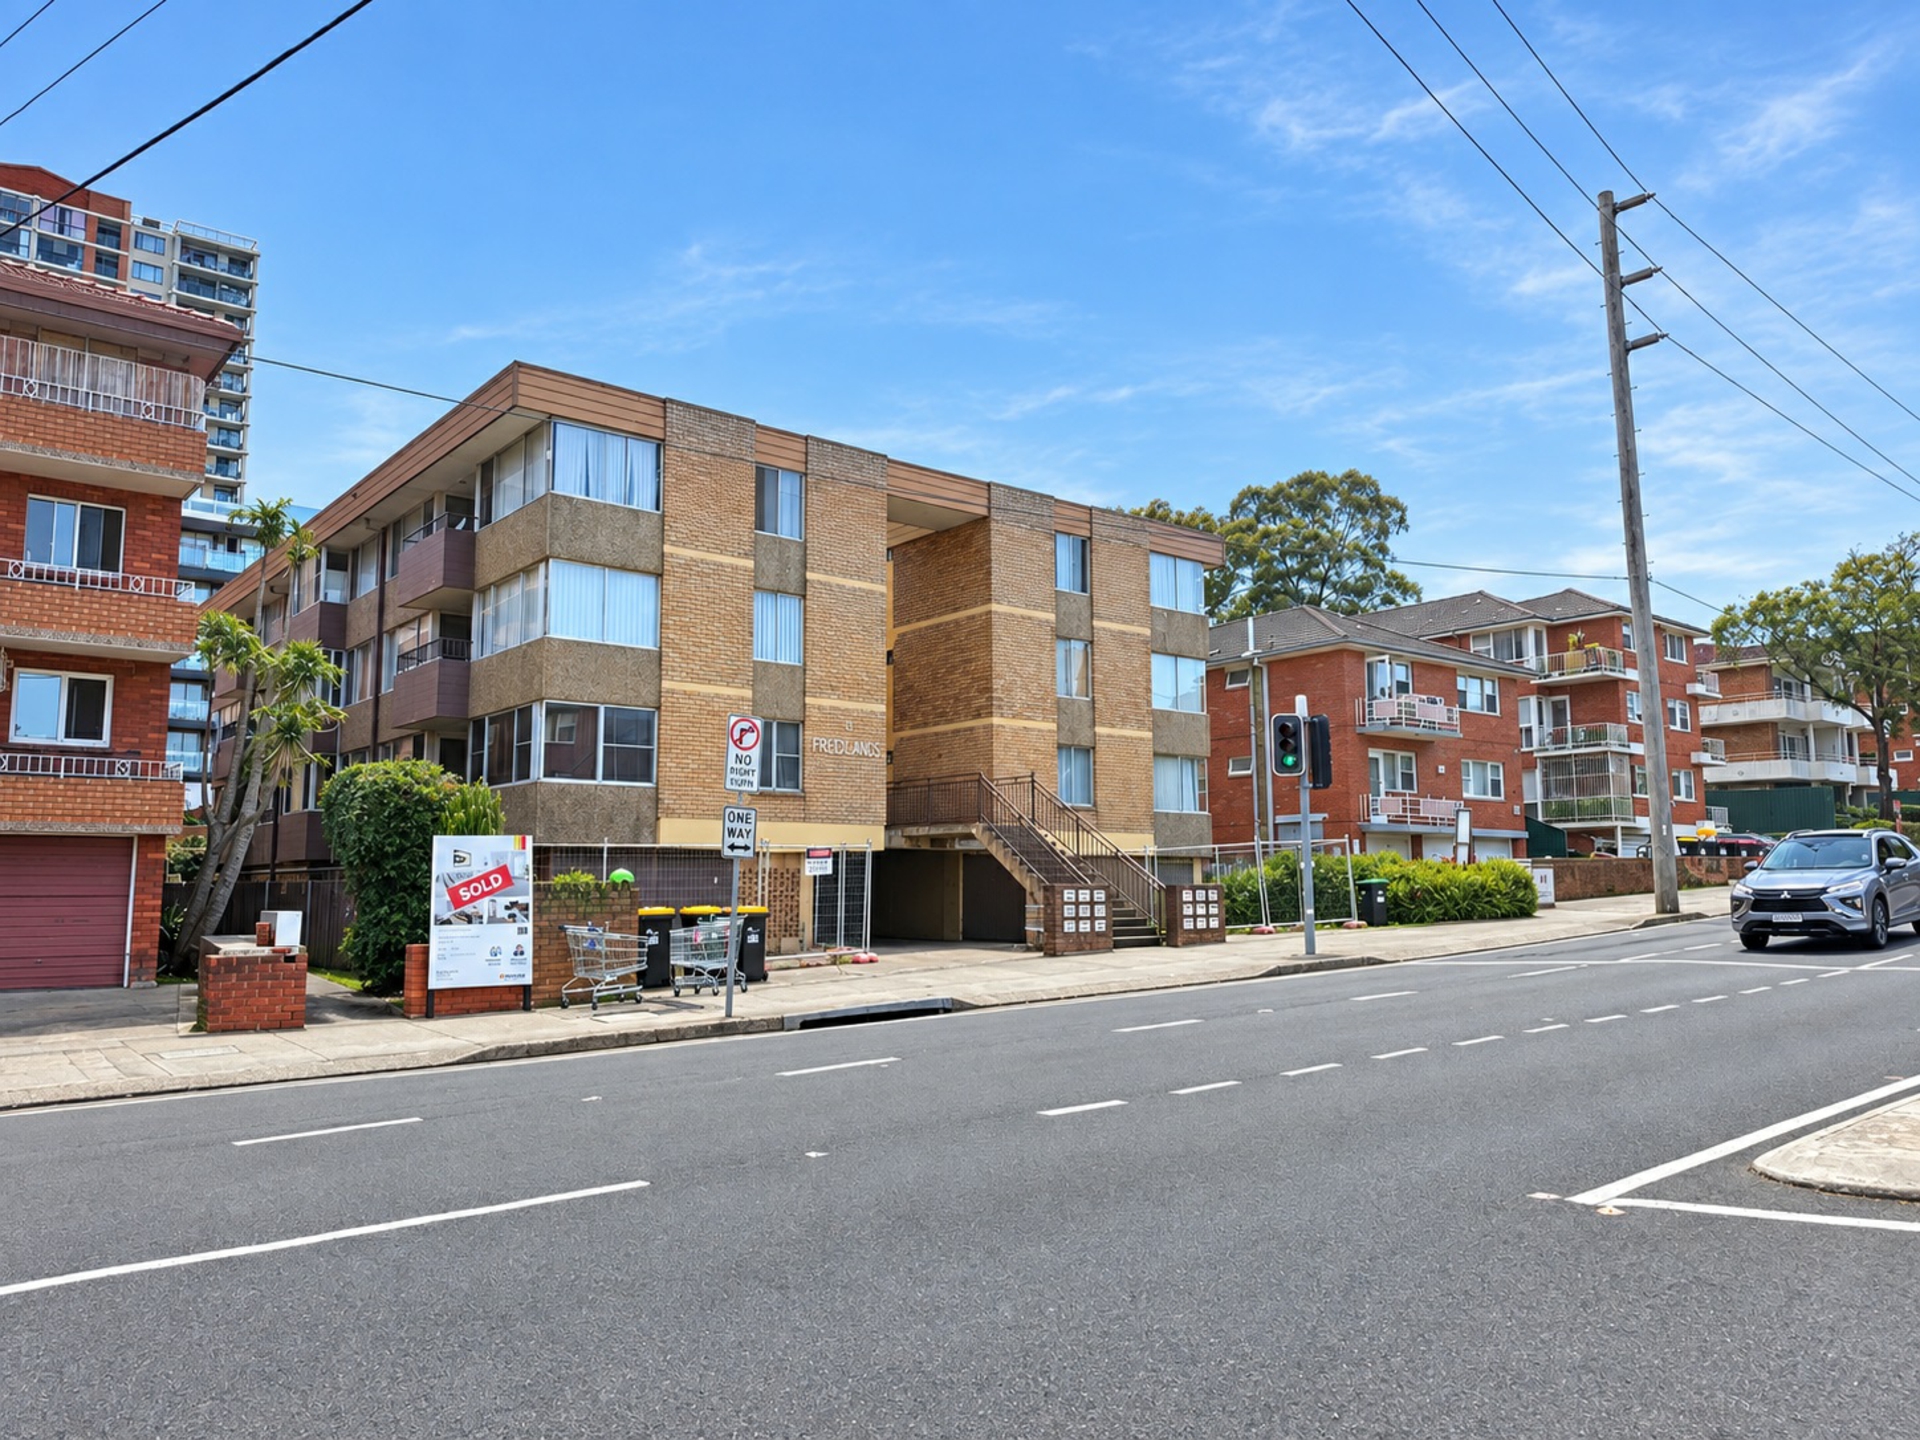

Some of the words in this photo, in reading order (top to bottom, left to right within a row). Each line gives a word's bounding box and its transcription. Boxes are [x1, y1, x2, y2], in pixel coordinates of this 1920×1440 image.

[735, 753, 752, 766] NO
[727, 810, 752, 824] ONE
[727, 827, 752, 839] WAY
[458, 873, 503, 901] SOLD
